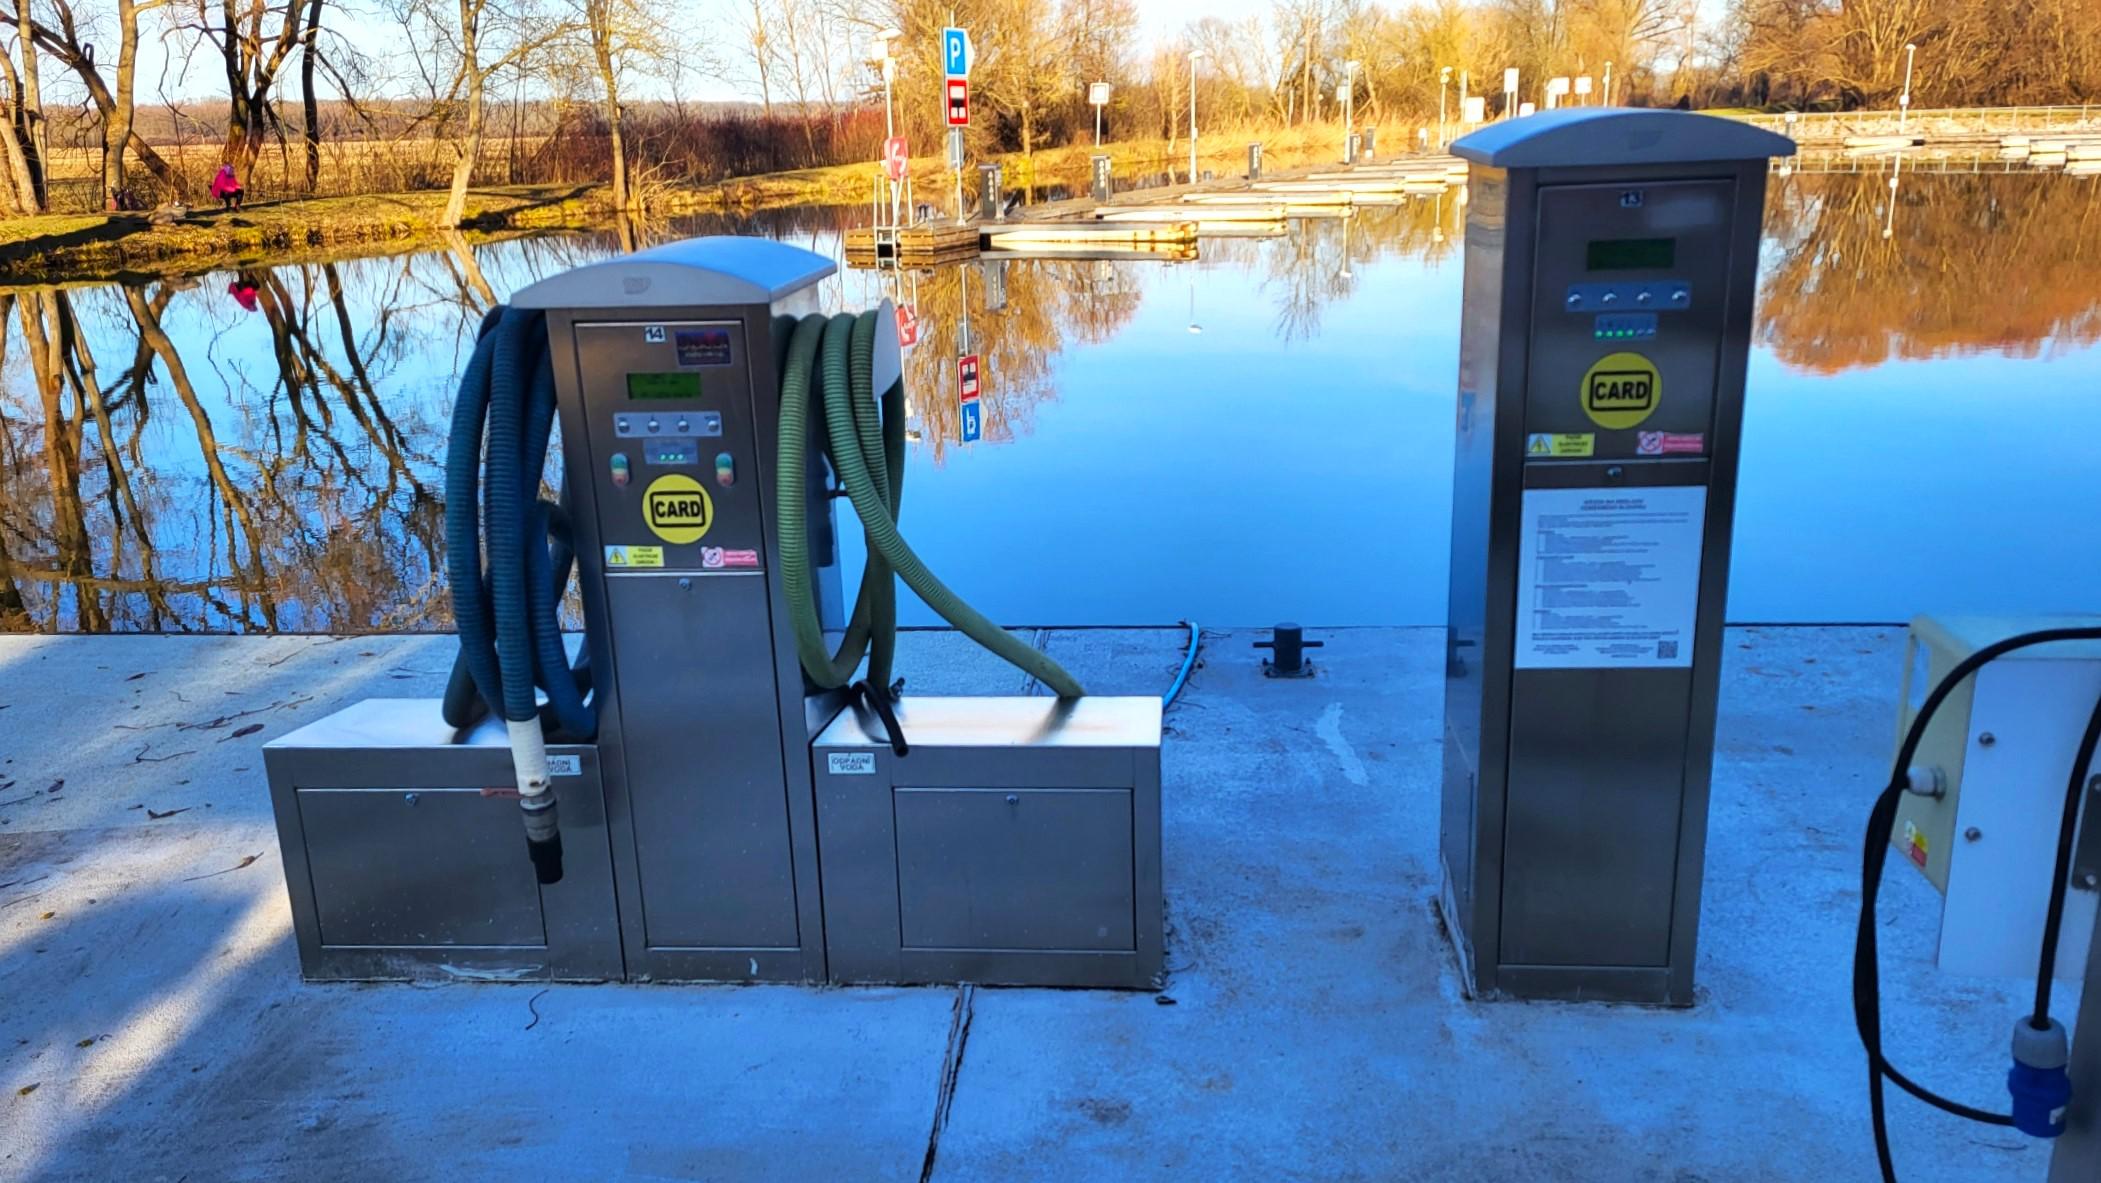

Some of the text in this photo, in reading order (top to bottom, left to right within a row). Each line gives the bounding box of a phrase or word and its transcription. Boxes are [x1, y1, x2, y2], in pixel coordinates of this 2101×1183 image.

[950, 37, 961, 68] P
[645, 328, 662, 339] 14
[1595, 381, 1649, 400] CARD
[655, 501, 701, 518] CARD
